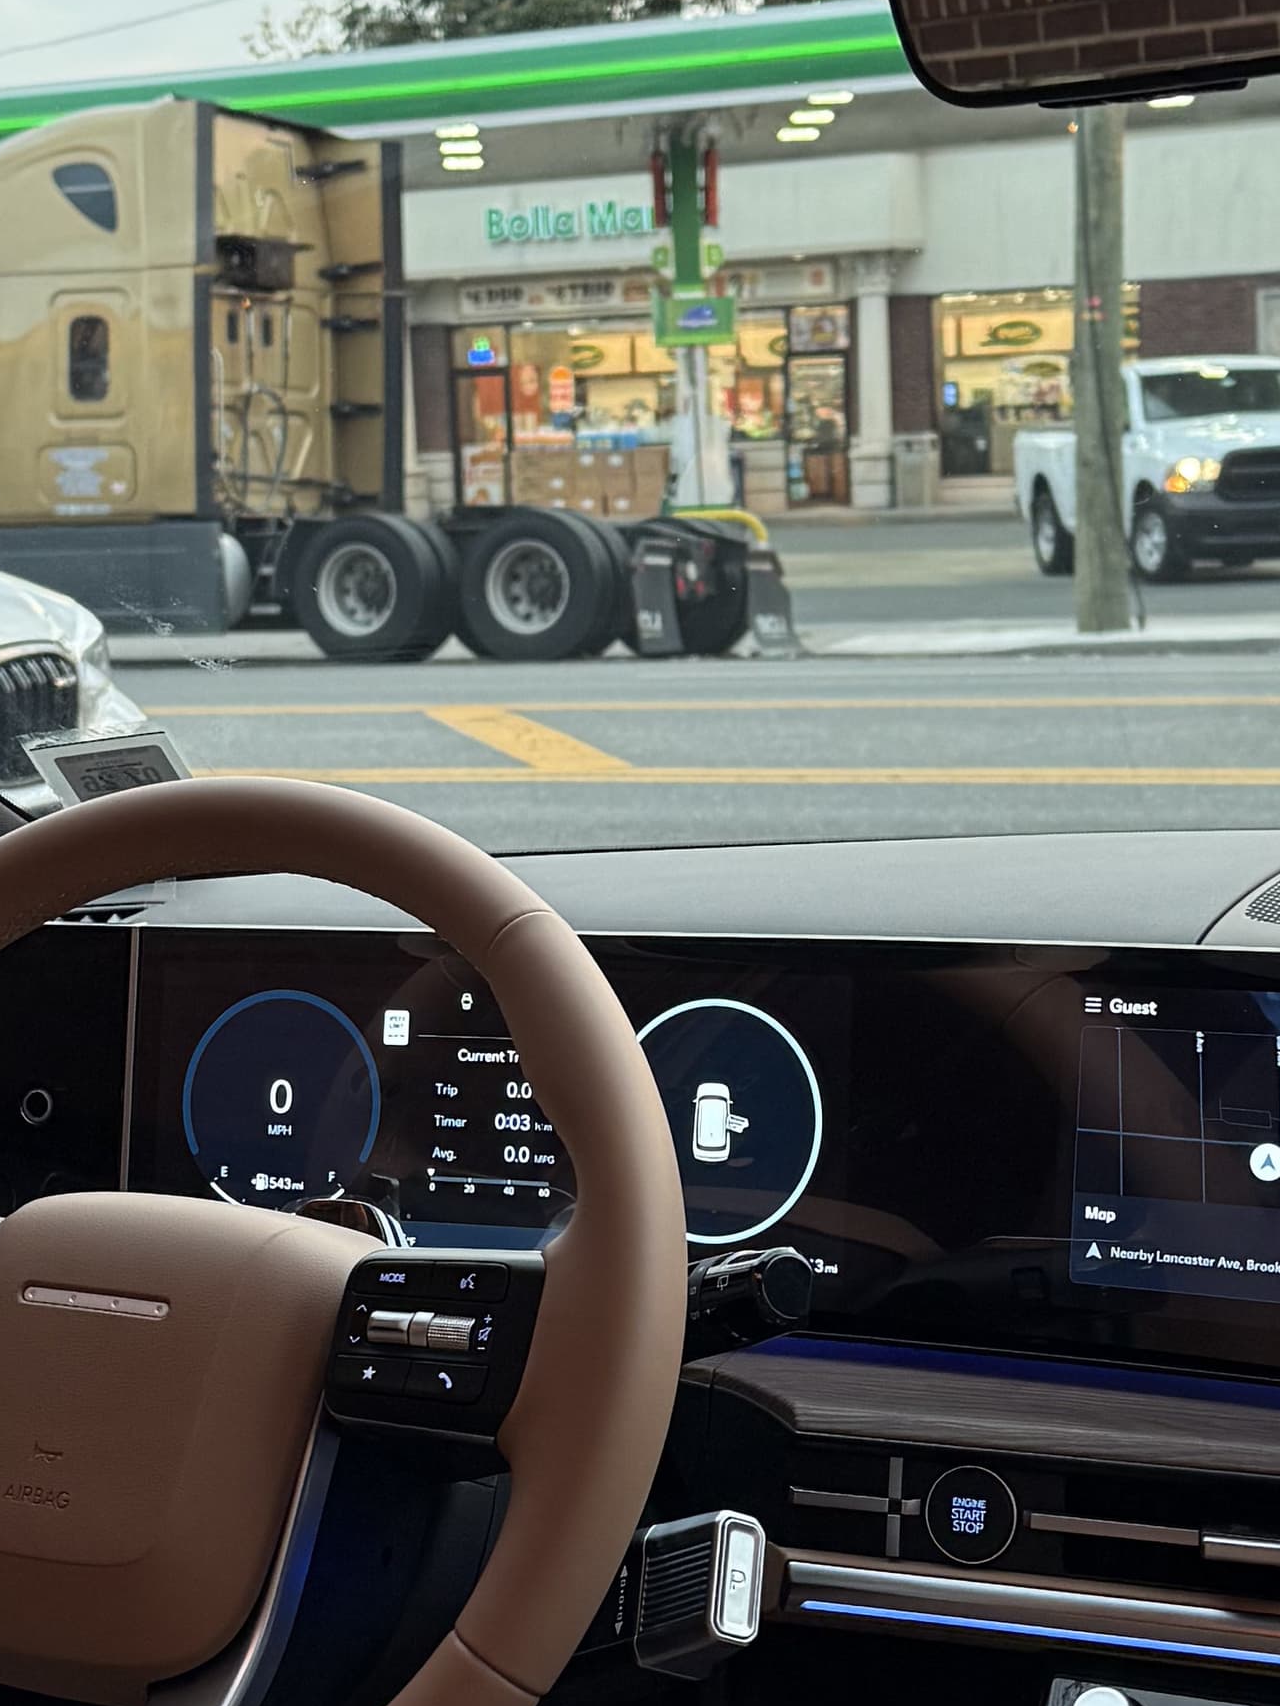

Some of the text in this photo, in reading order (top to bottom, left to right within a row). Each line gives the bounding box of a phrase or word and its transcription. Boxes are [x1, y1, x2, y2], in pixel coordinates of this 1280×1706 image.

[487, 205, 574, 241] Bolla
[1109, 998, 1158, 1016] Guest
[457, 1048, 506, 1063] Current
[270, 1079, 293, 1114] 0
[435, 1081, 532, 1099] Trip 0.0
[267, 1124, 292, 1136] MPH
[434, 1114, 468, 1127] Timer
[494, 1113, 531, 1131] 0:03
[432, 1146, 457, 1162] Avg.
[503, 1145, 530, 1163] 0.0
[220, 1166, 229, 1178] E
[328, 1171, 336, 1182] F
[429, 1182, 550, 1197] 0 20 40 60
[1084, 1206, 1116, 1224] Map
[1110, 1246, 1154, 1264] Nearby
[1156, 1250, 1215, 1268] Lancaster
[1217, 1256, 1244, 1271] Ave,
[379, 1273, 406, 1283] MODE
[2, 1483, 71, 1511] AIRBAG
[952, 1496, 987, 1509] ENGINE
[951, 1508, 987, 1522] START
[952, 1519, 984, 1534] STOP
